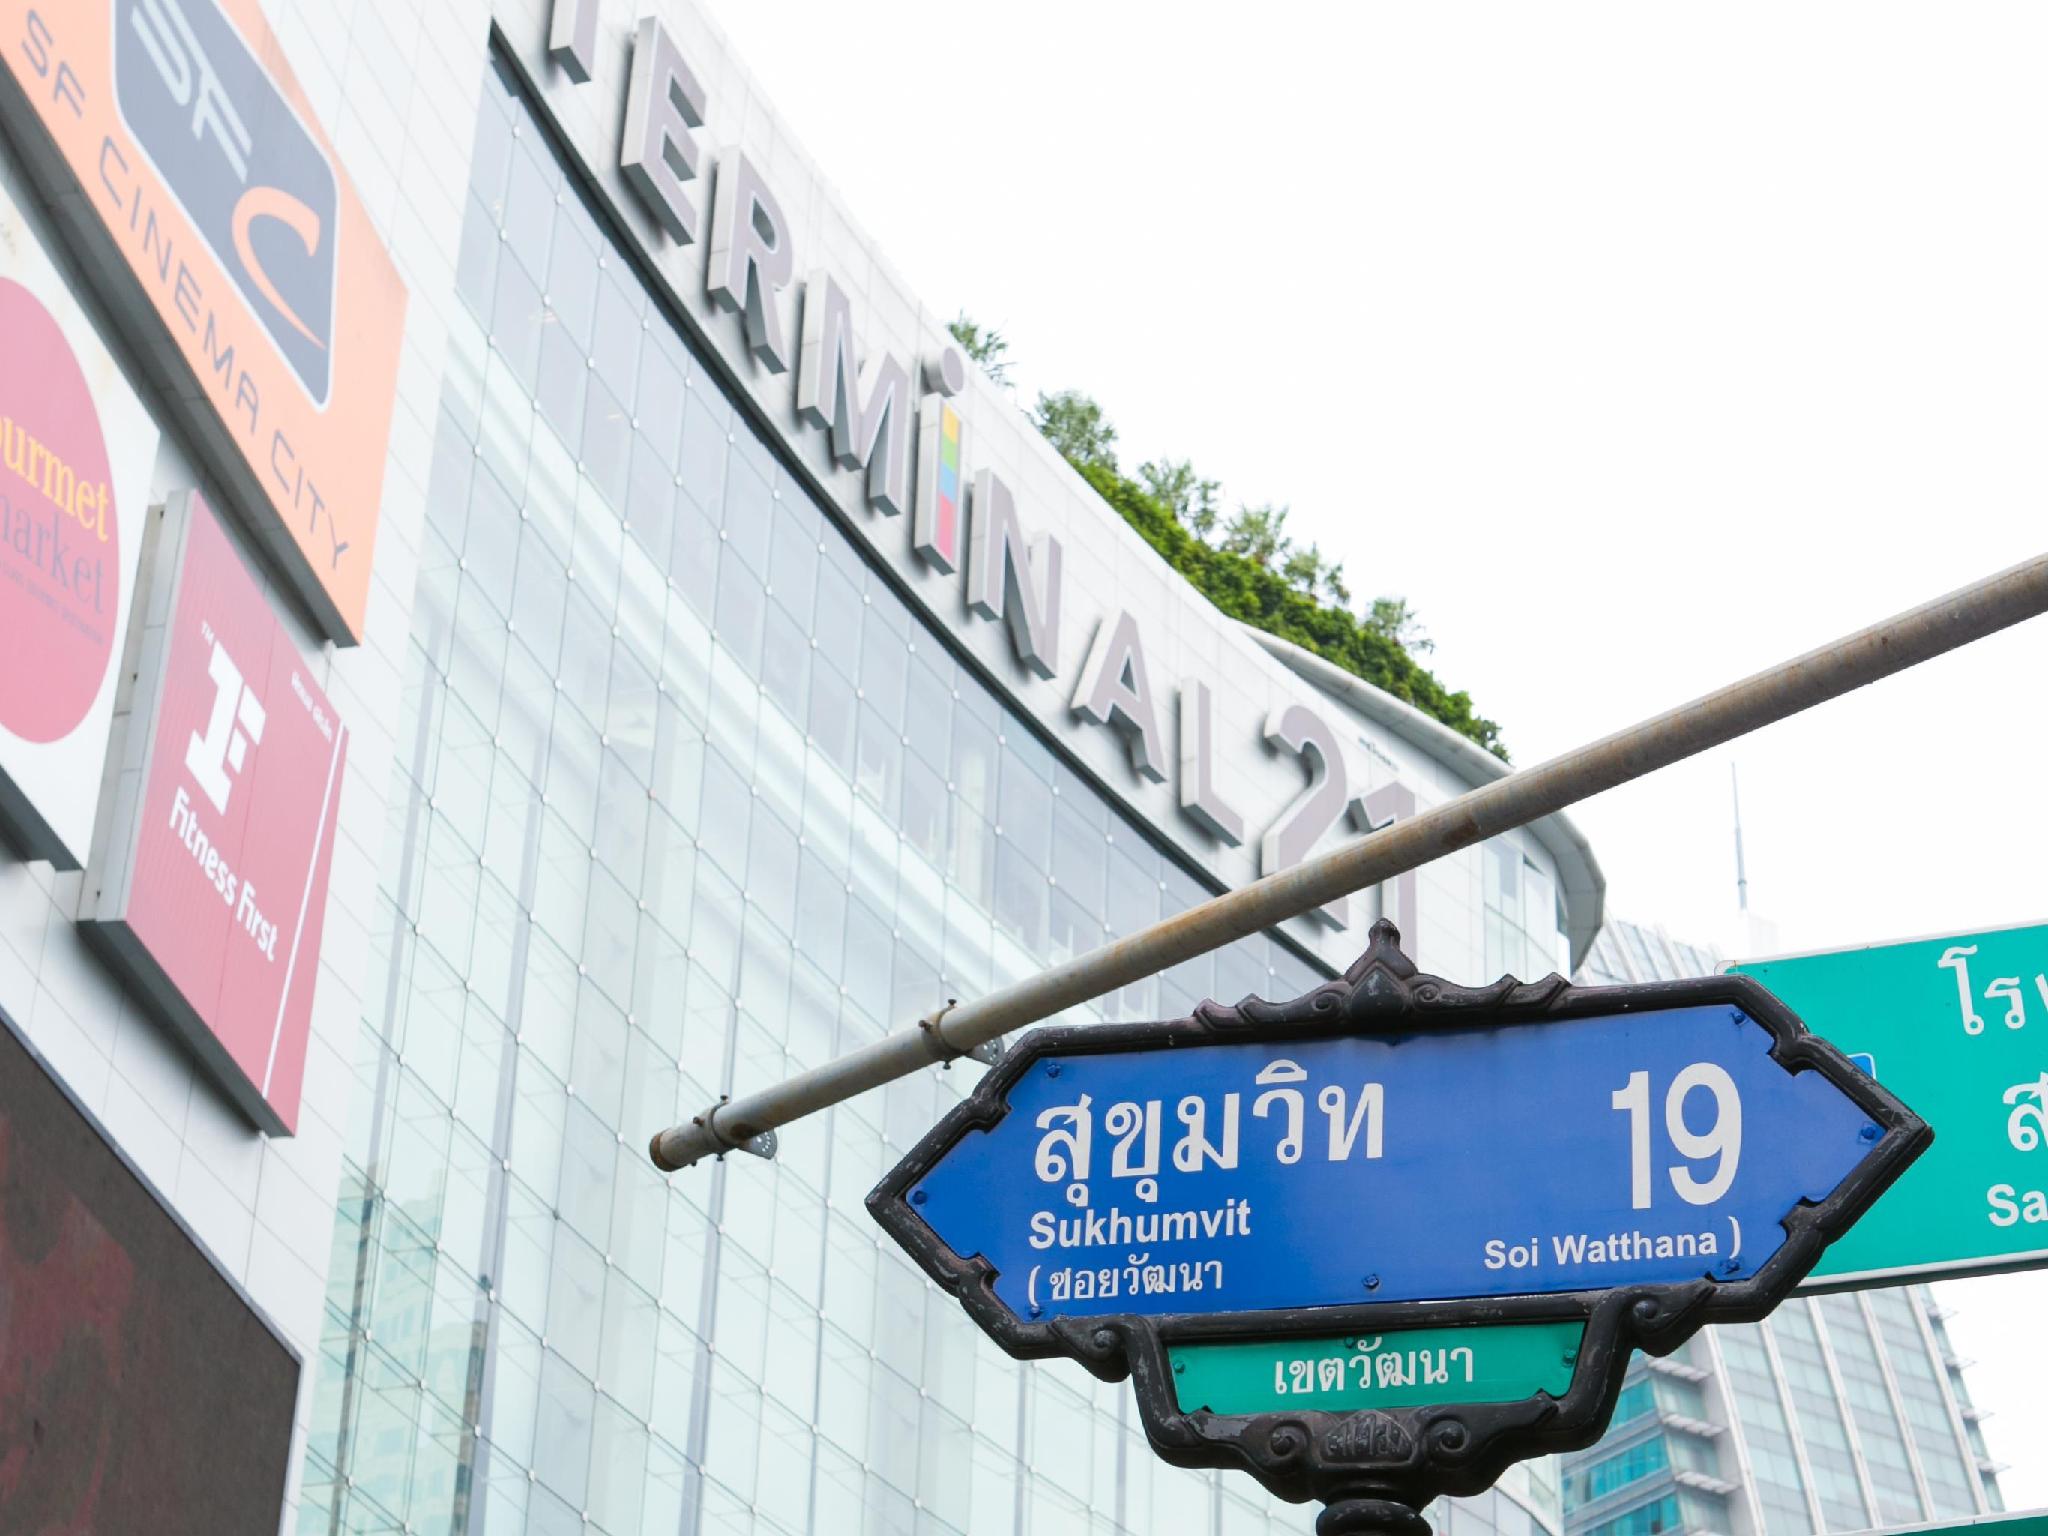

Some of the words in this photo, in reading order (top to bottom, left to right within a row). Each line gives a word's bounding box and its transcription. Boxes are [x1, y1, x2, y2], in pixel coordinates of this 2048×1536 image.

[21, 9, 86, 119] SF
[98, 135, 260, 434] CINEMA
[270, 429, 350, 570] CITY
[0, 415, 109, 543] urmet
[168, 785, 239, 907] Fitness
[235, 879, 279, 963] First
[1034, 1058, 1384, 1208] สุขุมวิท
[1611, 1062, 1742, 1210] 19
[1028, 1198, 1251, 1250] Sukhumvit
[1484, 1239, 1540, 1269] Soi
[1552, 1229, 1718, 1265] Watthana
[1274, 1336, 1473, 1394] เขตวัฒนา
